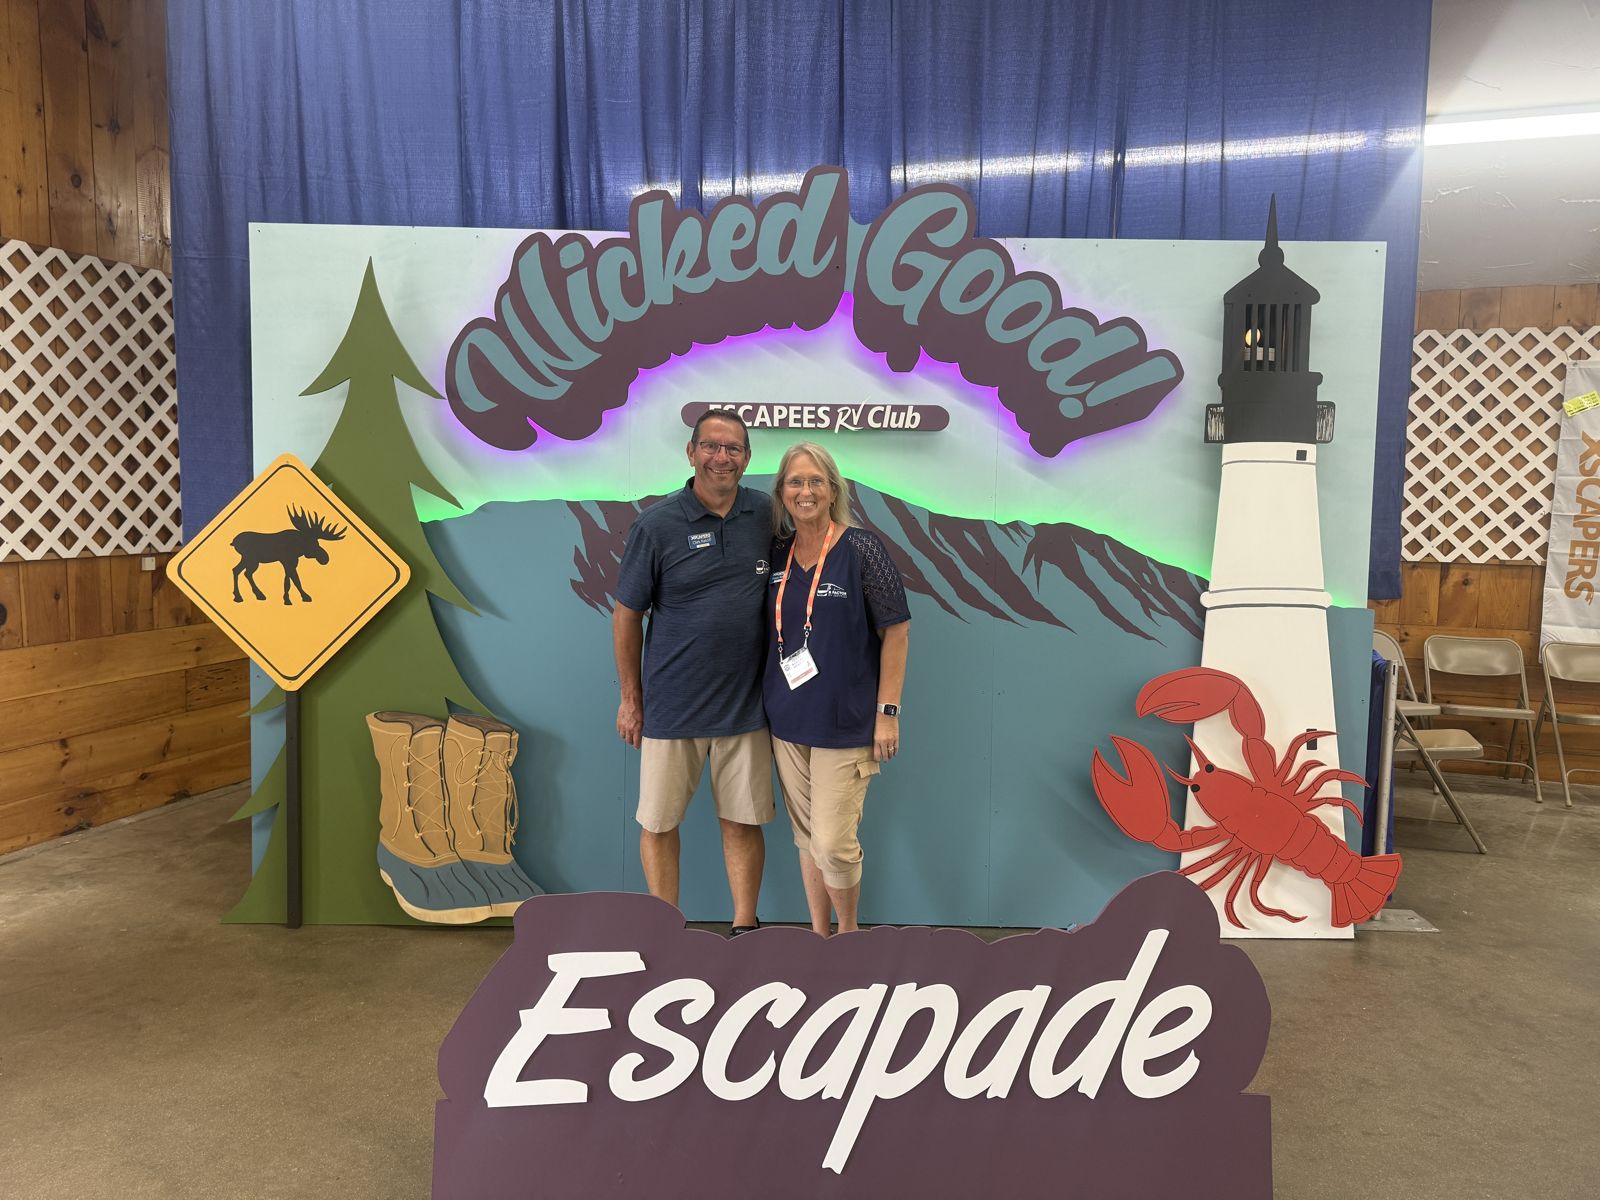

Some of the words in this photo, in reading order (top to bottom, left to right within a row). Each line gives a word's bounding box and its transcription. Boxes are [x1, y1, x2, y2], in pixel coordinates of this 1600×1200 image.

[454, 172, 841, 413] Wicked
[866, 191, 1178, 420] Good!
[709, 404, 831, 429] CAPEES
[834, 395, 870, 434] RV
[867, 405, 921, 429] Club
[1564, 430, 1600, 606] XSCAPERS
[484, 928, 1213, 1174] Escapade
